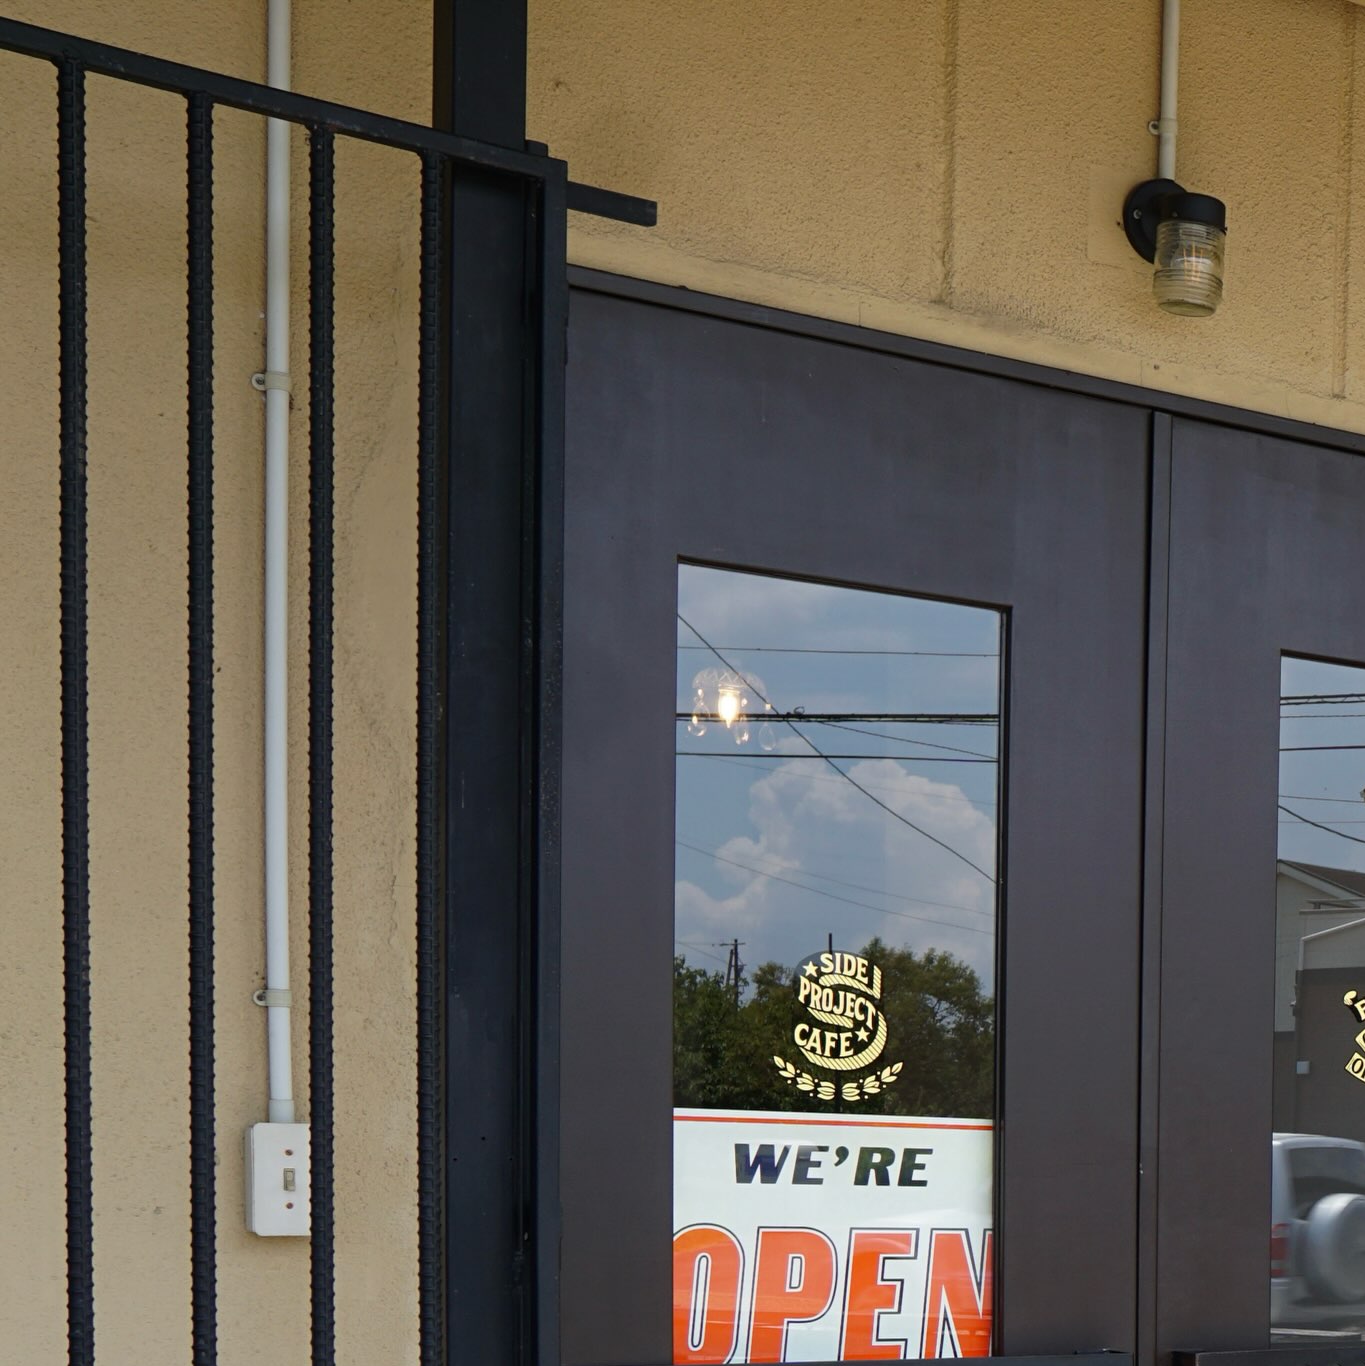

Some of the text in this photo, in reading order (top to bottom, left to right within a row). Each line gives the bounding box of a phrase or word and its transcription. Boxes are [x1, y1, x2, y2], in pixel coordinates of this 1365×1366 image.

[820, 953, 868, 984] SIDE
[799, 975, 876, 1030] PROJECT
[794, 1023, 854, 1057] CAFE
[734, 1143, 933, 1187] WE'RE
[673, 1222, 993, 1366] OPEN
